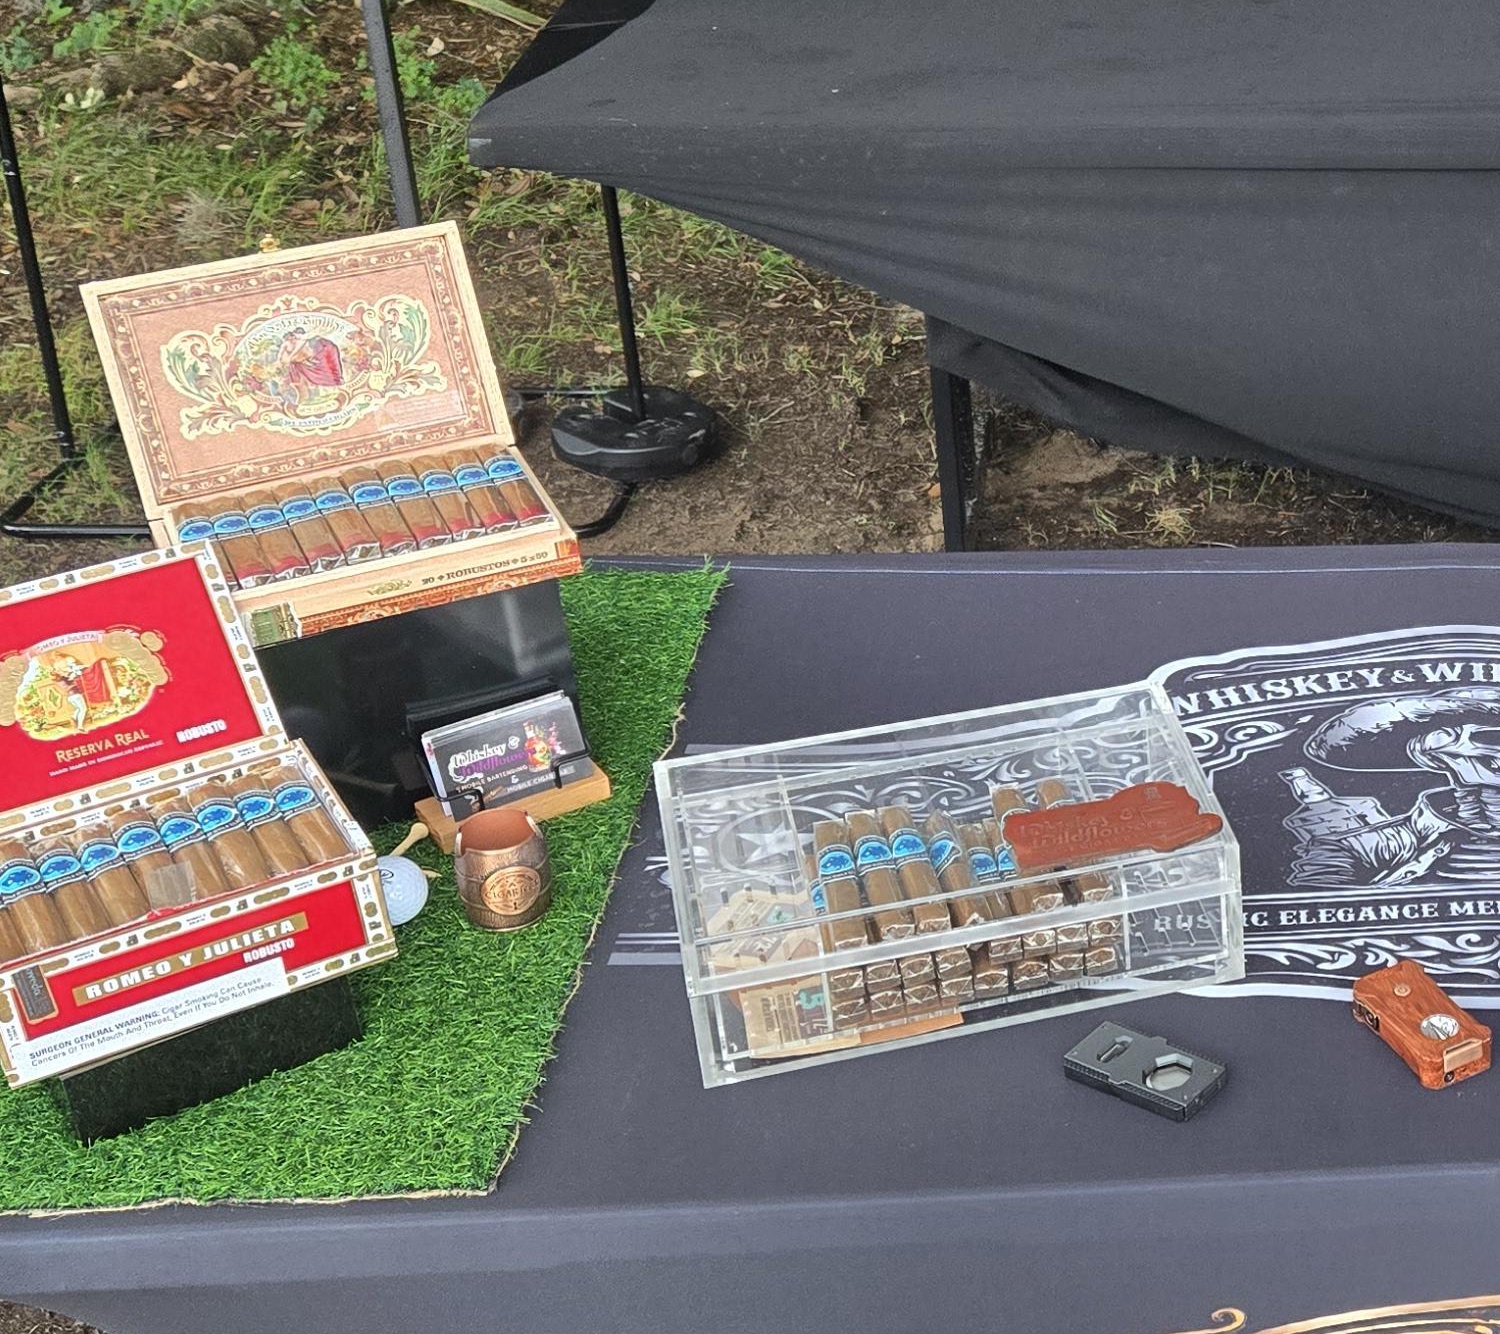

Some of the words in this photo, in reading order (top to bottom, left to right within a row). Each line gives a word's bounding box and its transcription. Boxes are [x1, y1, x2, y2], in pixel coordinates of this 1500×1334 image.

[446, 559, 510, 580] ROBUSTOS
[1172, 667, 1386, 715] WHISKEY
[1392, 668, 1415, 685] &
[55, 740, 113, 763] RESERVA
[114, 728, 149, 748] REAL
[451, 742, 506, 768] Whiskey
[508, 736, 520, 750] &
[1279, 901, 1437, 928] ELEGANCE
[85, 960, 172, 1000] ROMEO
[178, 951, 194, 967] Y
[203, 919, 295, 960] JULIETA
[243, 938, 295, 964] ROBUSTO
[29, 1040, 72, 1061] SURGEON
[73, 1027, 114, 1049] GENERAL
[114, 1010, 161, 1036] WARNING:
[161, 1002, 183, 1018] Cigar
[184, 990, 219, 1010] Smoking
[220, 984, 235, 996] Can
[237, 977, 262, 990] Cause
[31, 1050, 67, 1067] Cancers
[97, 1032, 124, 1048] Mouth
[126, 1024, 143, 1038] And
[174, 1007, 194, 1021] Even
[202, 999, 217, 1011] You
[218, 994, 231, 1006] Do
[231, 988, 247, 1001] Not
